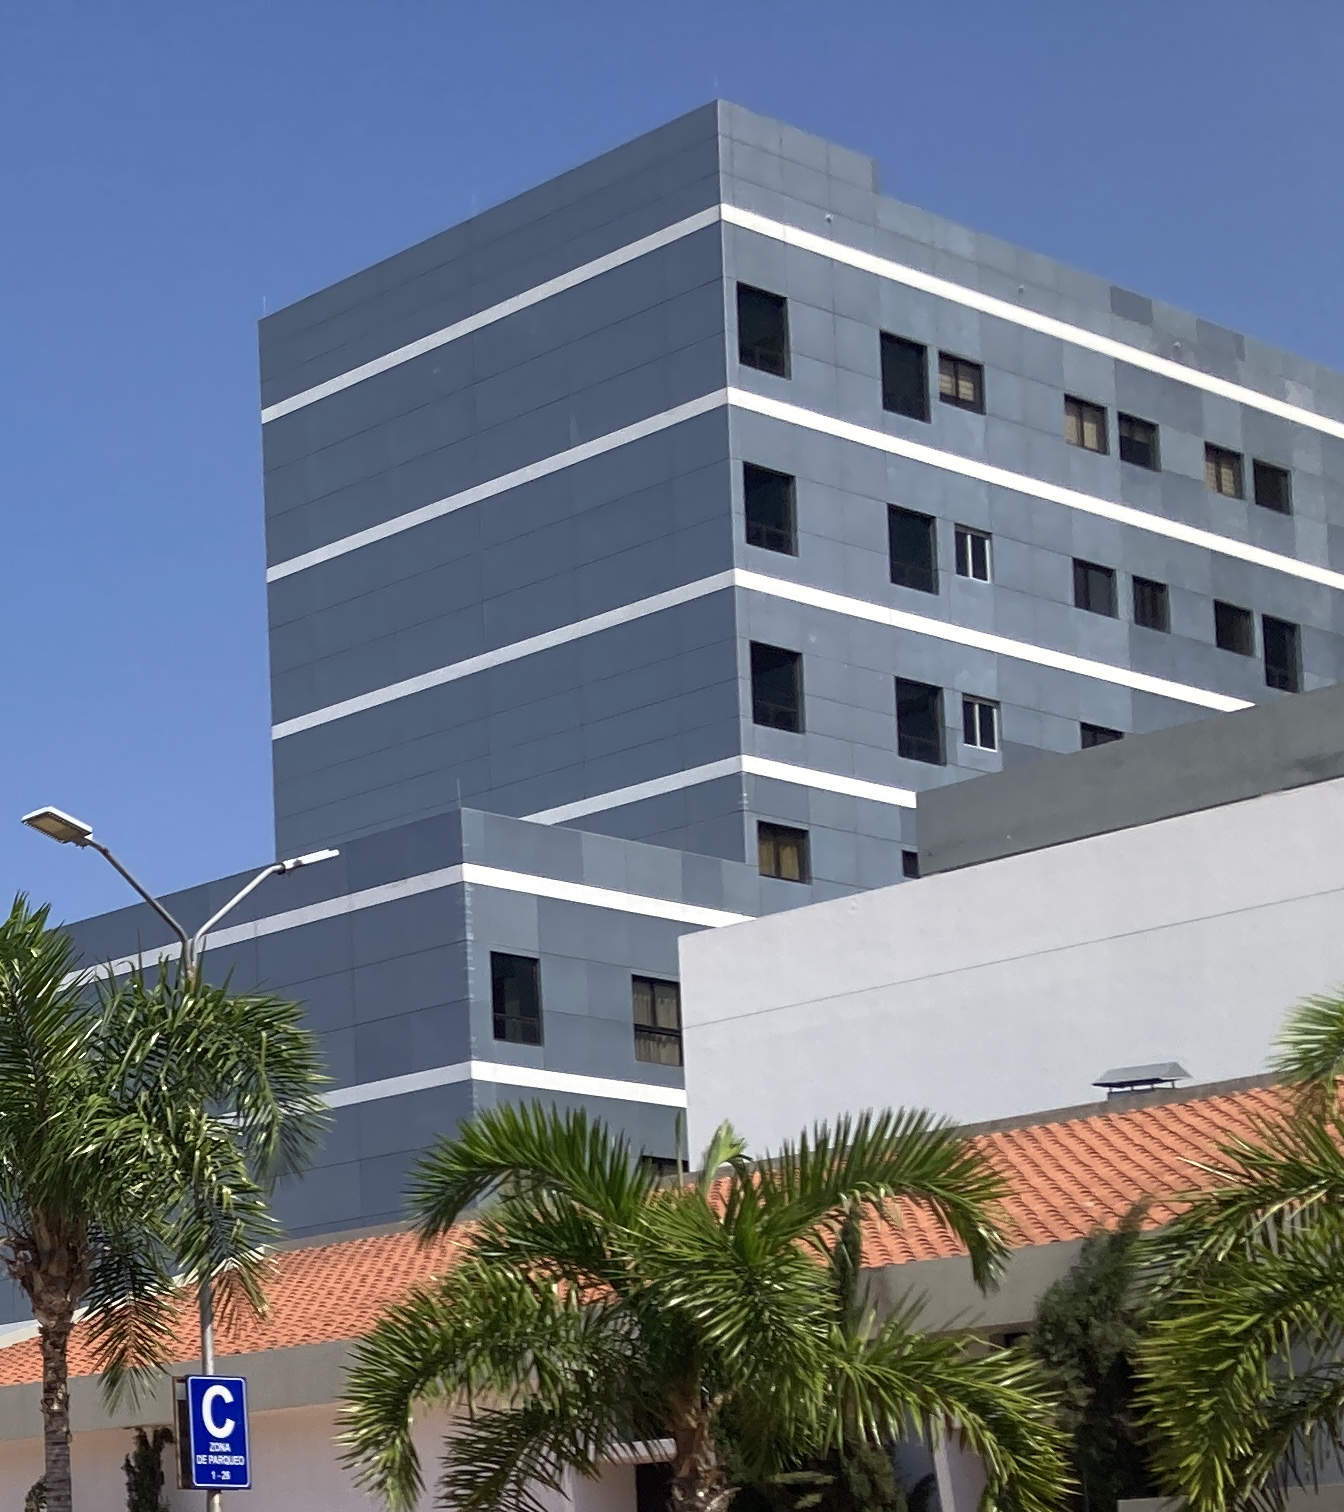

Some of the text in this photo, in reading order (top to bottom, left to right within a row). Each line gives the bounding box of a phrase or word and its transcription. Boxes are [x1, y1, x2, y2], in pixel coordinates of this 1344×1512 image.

[201, 1384, 235, 1439] C
[209, 1441, 232, 1453] ZONA
[196, 1454, 245, 1466] DE PARQUEO
